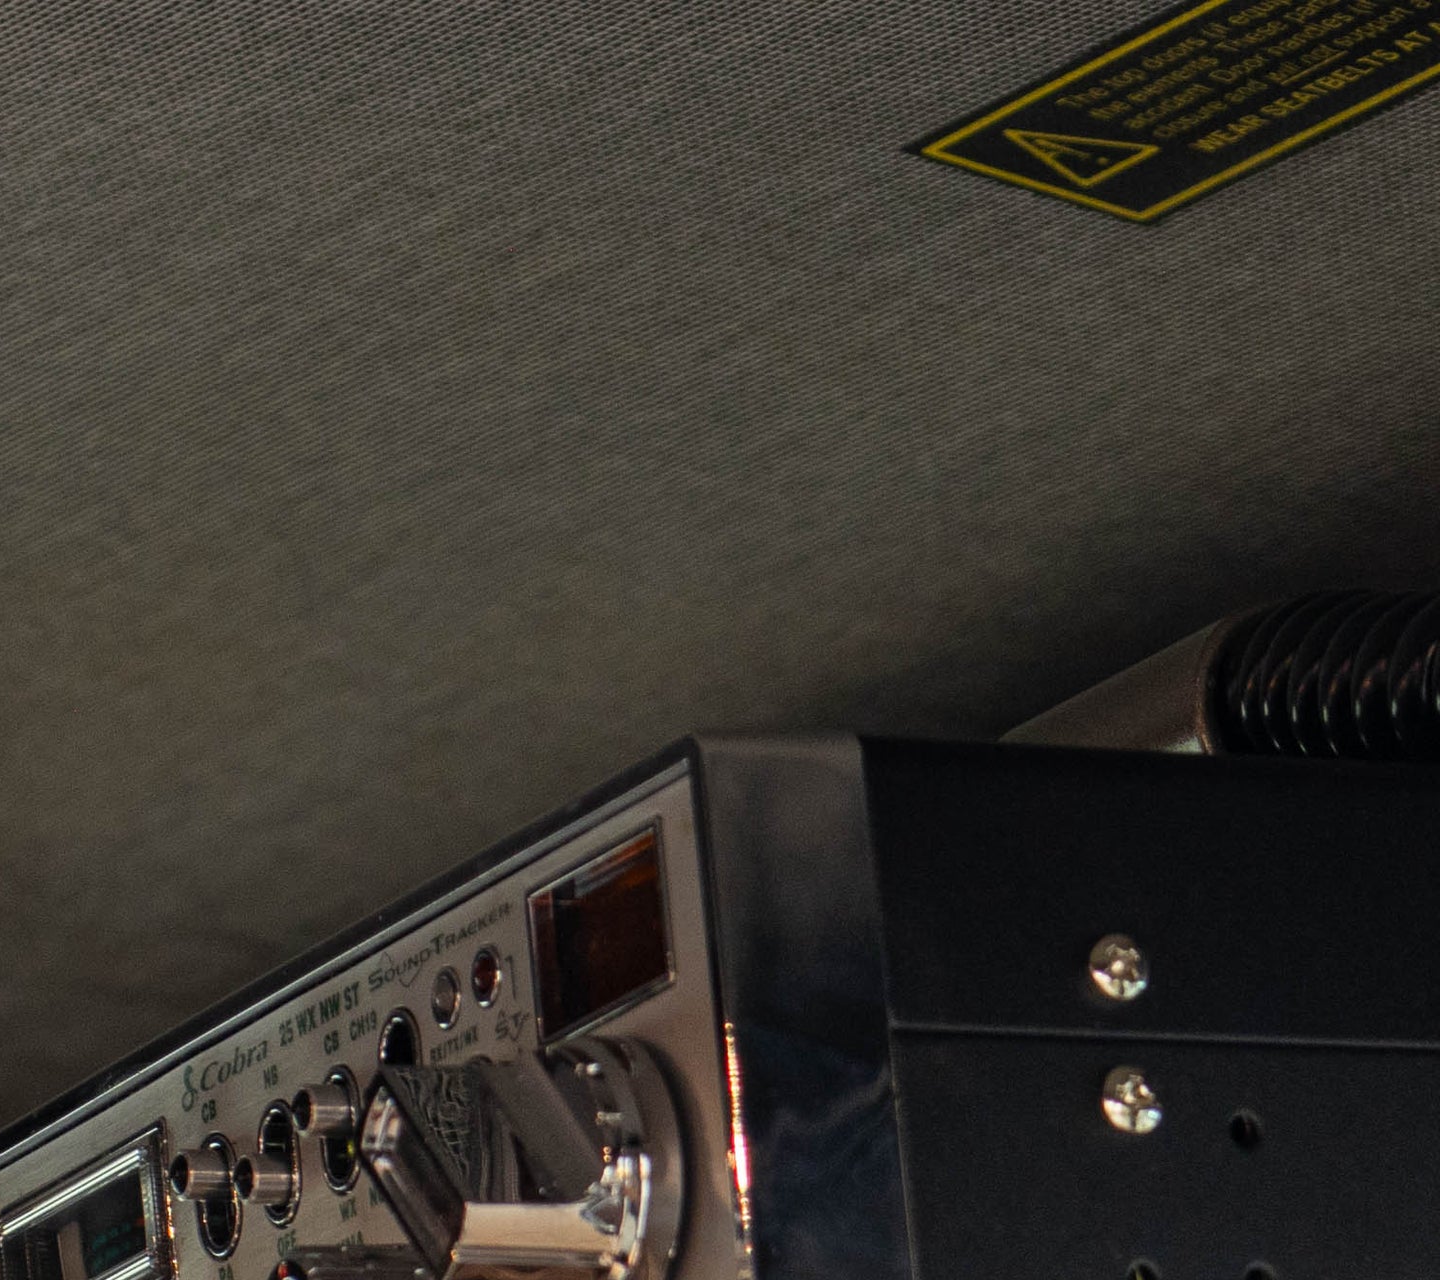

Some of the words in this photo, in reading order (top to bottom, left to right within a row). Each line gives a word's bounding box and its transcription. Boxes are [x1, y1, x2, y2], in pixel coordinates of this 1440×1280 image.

[1057, 88, 1109, 107] The
[1103, 69, 1146, 88] top
[1143, 38, 1206, 69] doors
[1195, 116, 1262, 151] WEAR
[1263, 51, 1397, 116] SEATBELTS
[1396, 31, 1429, 52] AT
[1209, 54, 1265, 83] Door
[201, 1040, 268, 1091] Cobra
[279, 1022, 294, 1047] 25
[296, 1005, 317, 1037] WX
[320, 992, 340, 1022] NW
[344, 982, 360, 1011] ST
[324, 1030, 339, 1055] CB
[350, 1011, 377, 1041] CH19
[201, 1099, 217, 1124] CB
